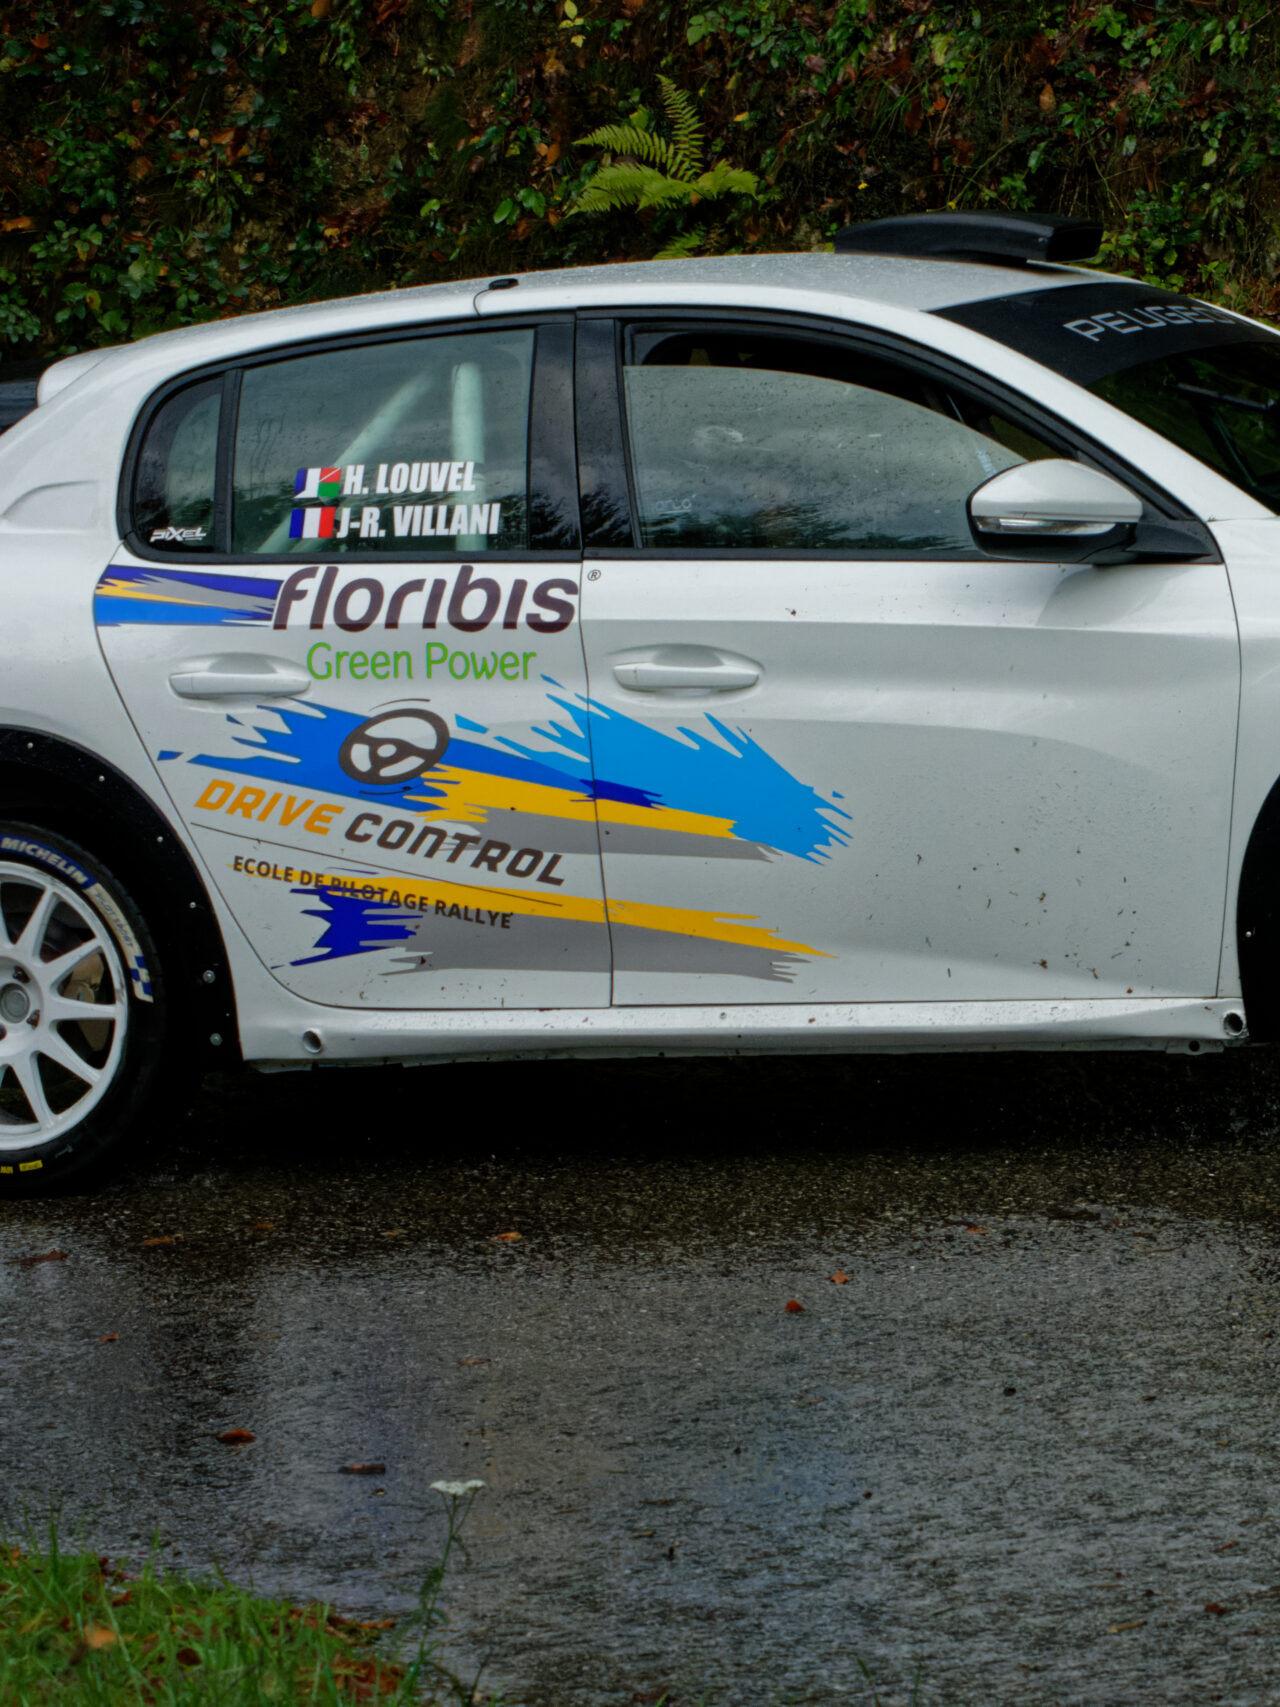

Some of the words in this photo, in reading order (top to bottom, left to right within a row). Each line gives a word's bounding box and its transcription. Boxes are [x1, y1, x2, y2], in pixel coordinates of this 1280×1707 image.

[343, 465, 371, 494] H.
[376, 462, 476, 493] LOUVEL
[335, 506, 386, 538] J-R.
[392, 503, 500, 536] VILLANI
[272, 565, 579, 633] floribis
[307, 642, 413, 680] Green
[425, 642, 537, 680] Power
[194, 779, 345, 836] DRIVE
[344, 812, 568, 887] CONTROL
[1, 836, 89, 885] MICHELIN
[233, 855, 294, 883] ECOLE
[300, 869, 325, 890] DE
[330, 877, 429, 912] PILOTAGE
[434, 899, 514, 929] RALLYE
